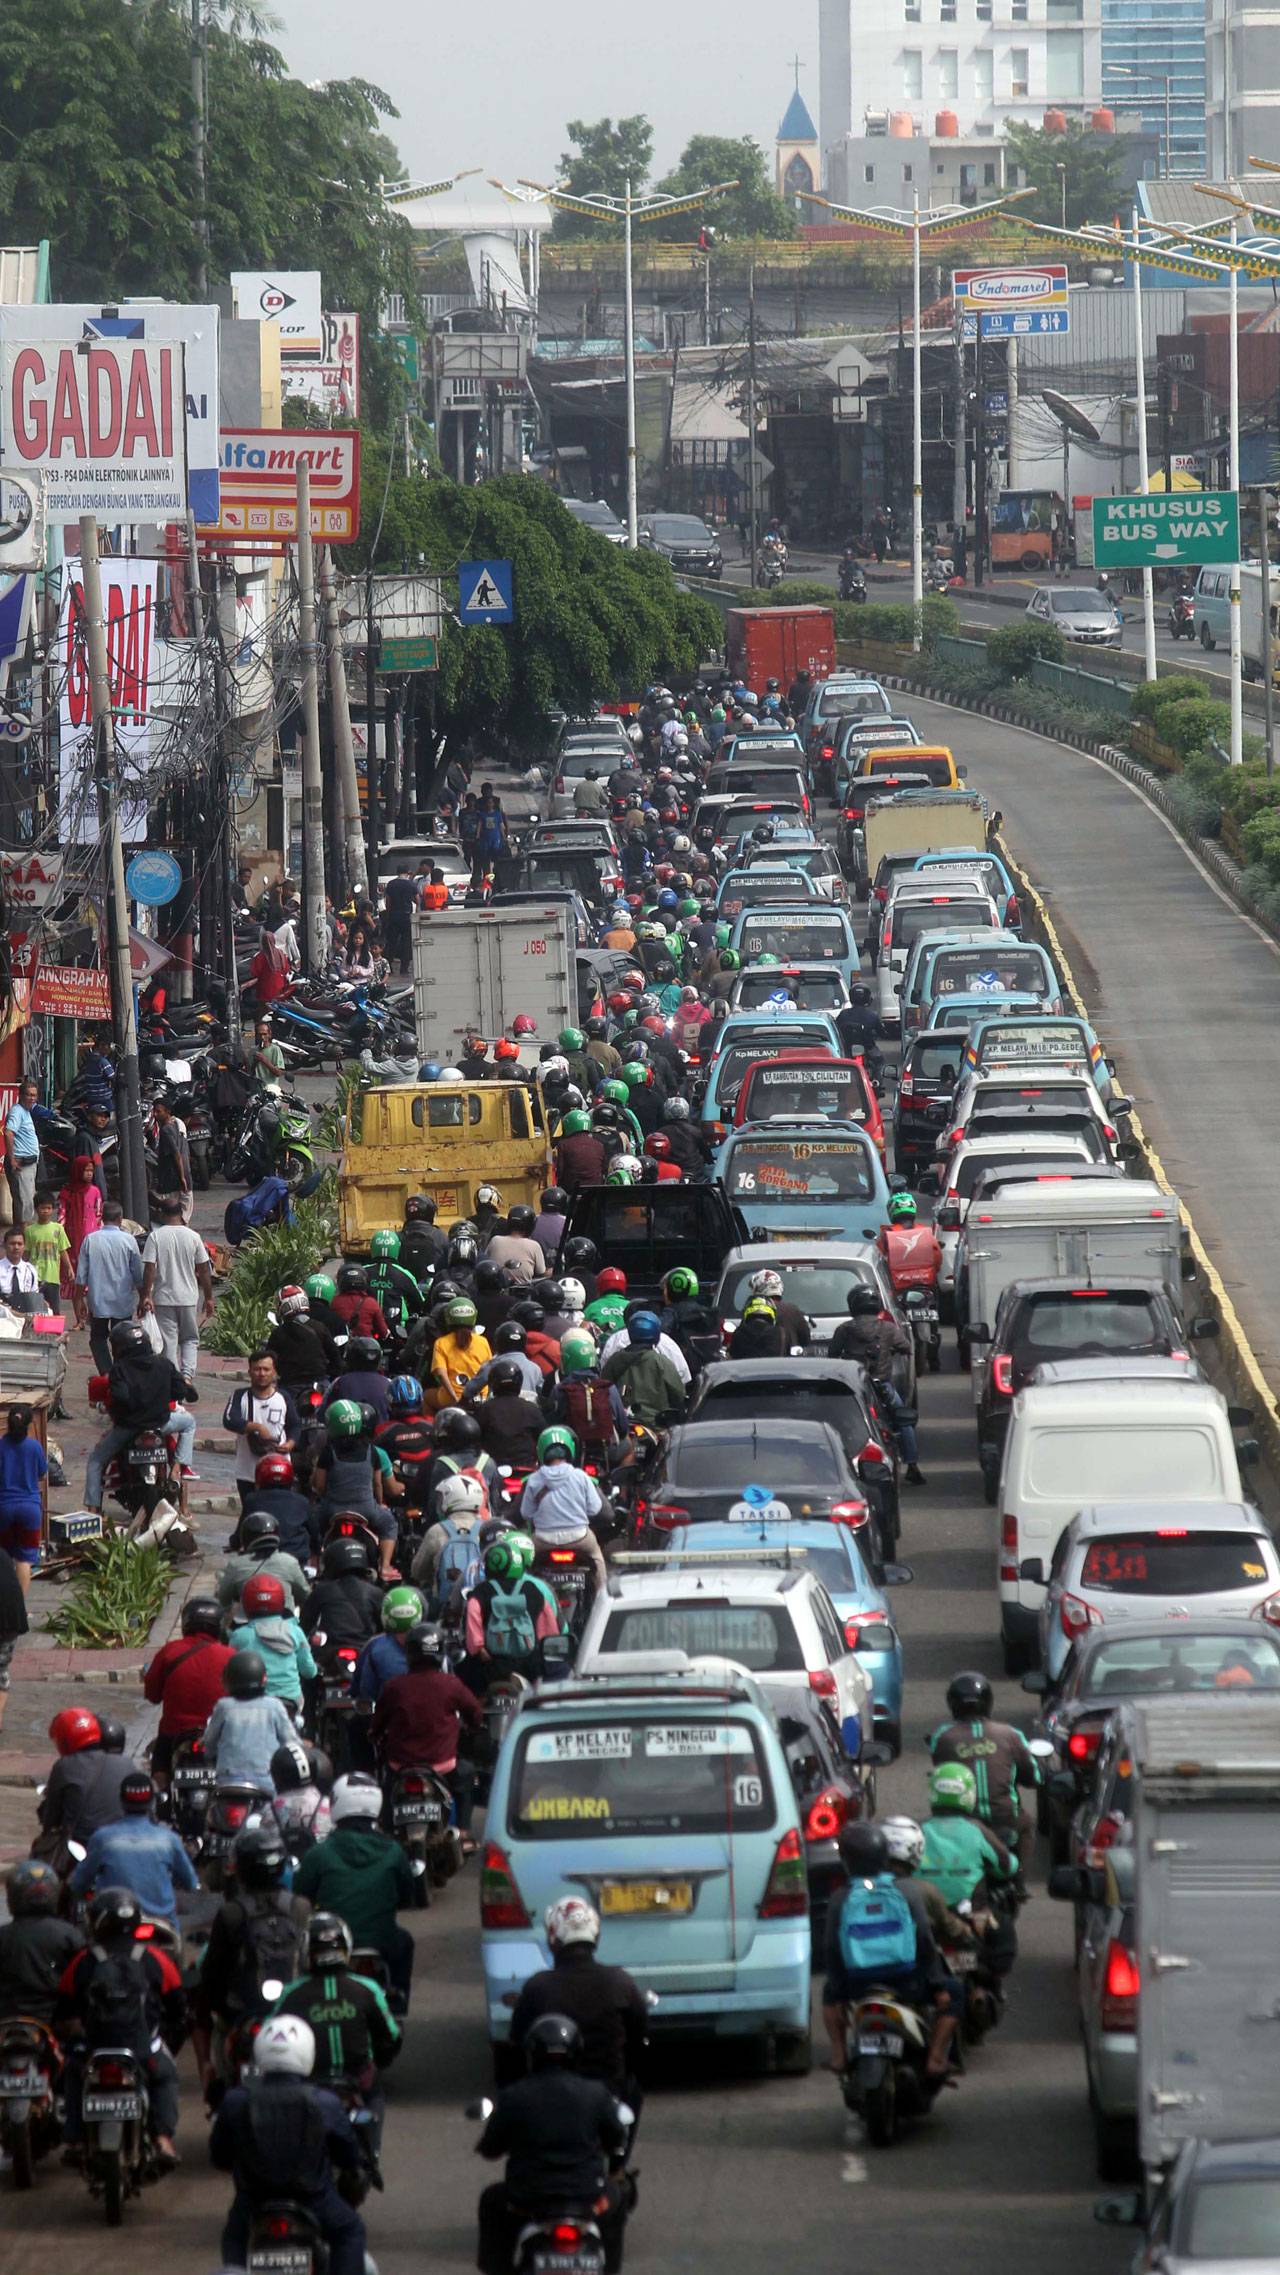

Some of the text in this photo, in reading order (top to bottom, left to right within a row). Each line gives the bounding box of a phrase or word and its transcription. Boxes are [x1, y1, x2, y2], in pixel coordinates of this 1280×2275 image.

[975, 280, 1047, 295] Indomaret
[12, 348, 173, 460] GADAI
[218, 442, 344, 469] lfamart
[64, 469, 78, 482] PS4
[79, 468, 94, 482] DAN
[95, 468, 138, 482] ELEKTRONIK
[139, 469, 170, 482] LAINNYA
[82, 495, 107, 509] DENGAN
[107, 495, 127, 509] BUNGA
[127, 494, 144, 508] YANG
[143, 494, 181, 508] TERJANGKAU
[1107, 500, 1222, 519] KHUSUS
[1103, 520, 1230, 541] BUS WAY
[67, 581, 151, 728] GDAI
[530, 941, 547, 954] 050
[37, 969, 94, 987] ANUGRAH
[939, 979, 954, 990] 16
[816, 1072, 849, 1081] CILILITAN
[793, 1144, 810, 1160] 16
[739, 1172, 756, 1189] 16
[375, 1238, 396, 1246] Grab
[370, 1280, 393, 1289] Grab
[339, 1411, 361, 1424] Grab
[740, 1510, 781, 1519] TAKSI
[628, 1616, 689, 1650] POLISI
[576, 1732, 632, 1746] MELAYU
[667, 1730, 717, 1743] MINGGU
[956, 1738, 998, 1758] Grab
[739, 1782, 761, 1805] 16
[310, 2000, 357, 2022] Grab
